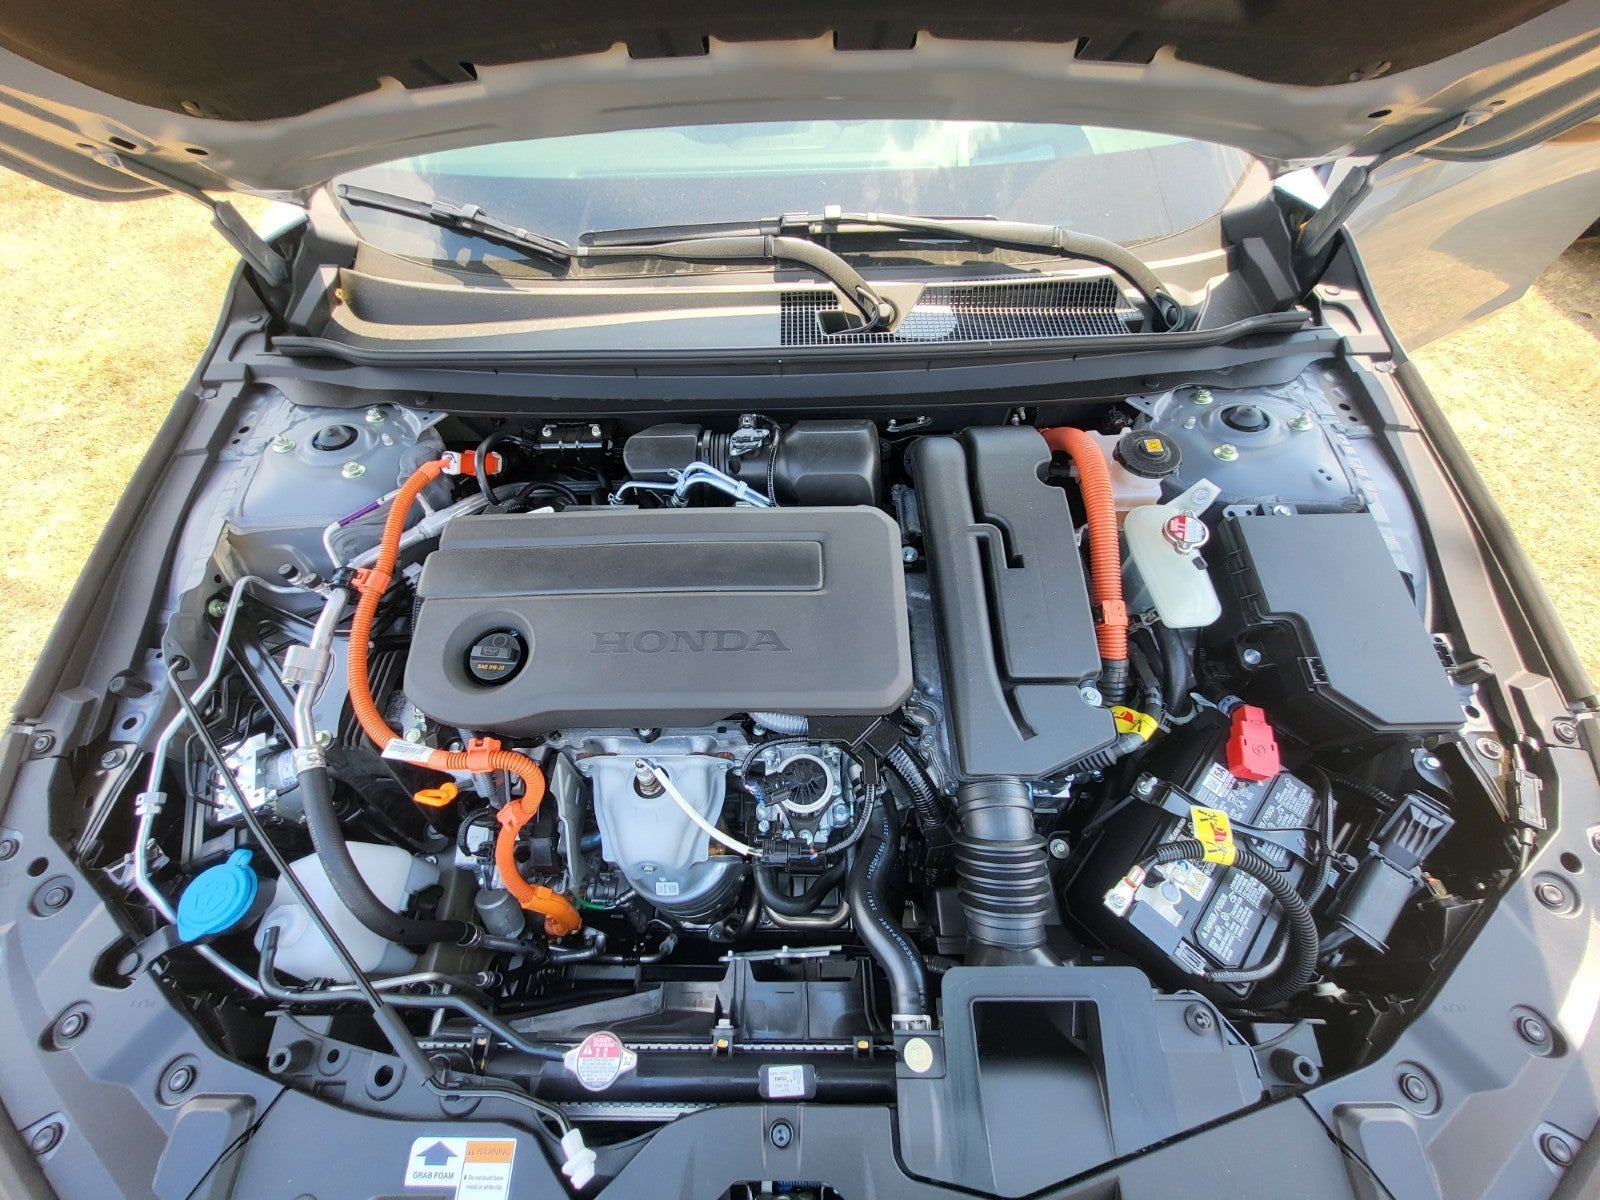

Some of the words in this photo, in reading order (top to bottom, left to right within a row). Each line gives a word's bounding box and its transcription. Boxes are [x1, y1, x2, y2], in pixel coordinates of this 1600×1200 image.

[590, 628, 793, 654] HONDA
[1213, 766, 1227, 779] 5A
[476, 1148, 512, 1156] WARNING
[412, 1171, 433, 1180] GRAB
[433, 1171, 455, 1180] FOAM
